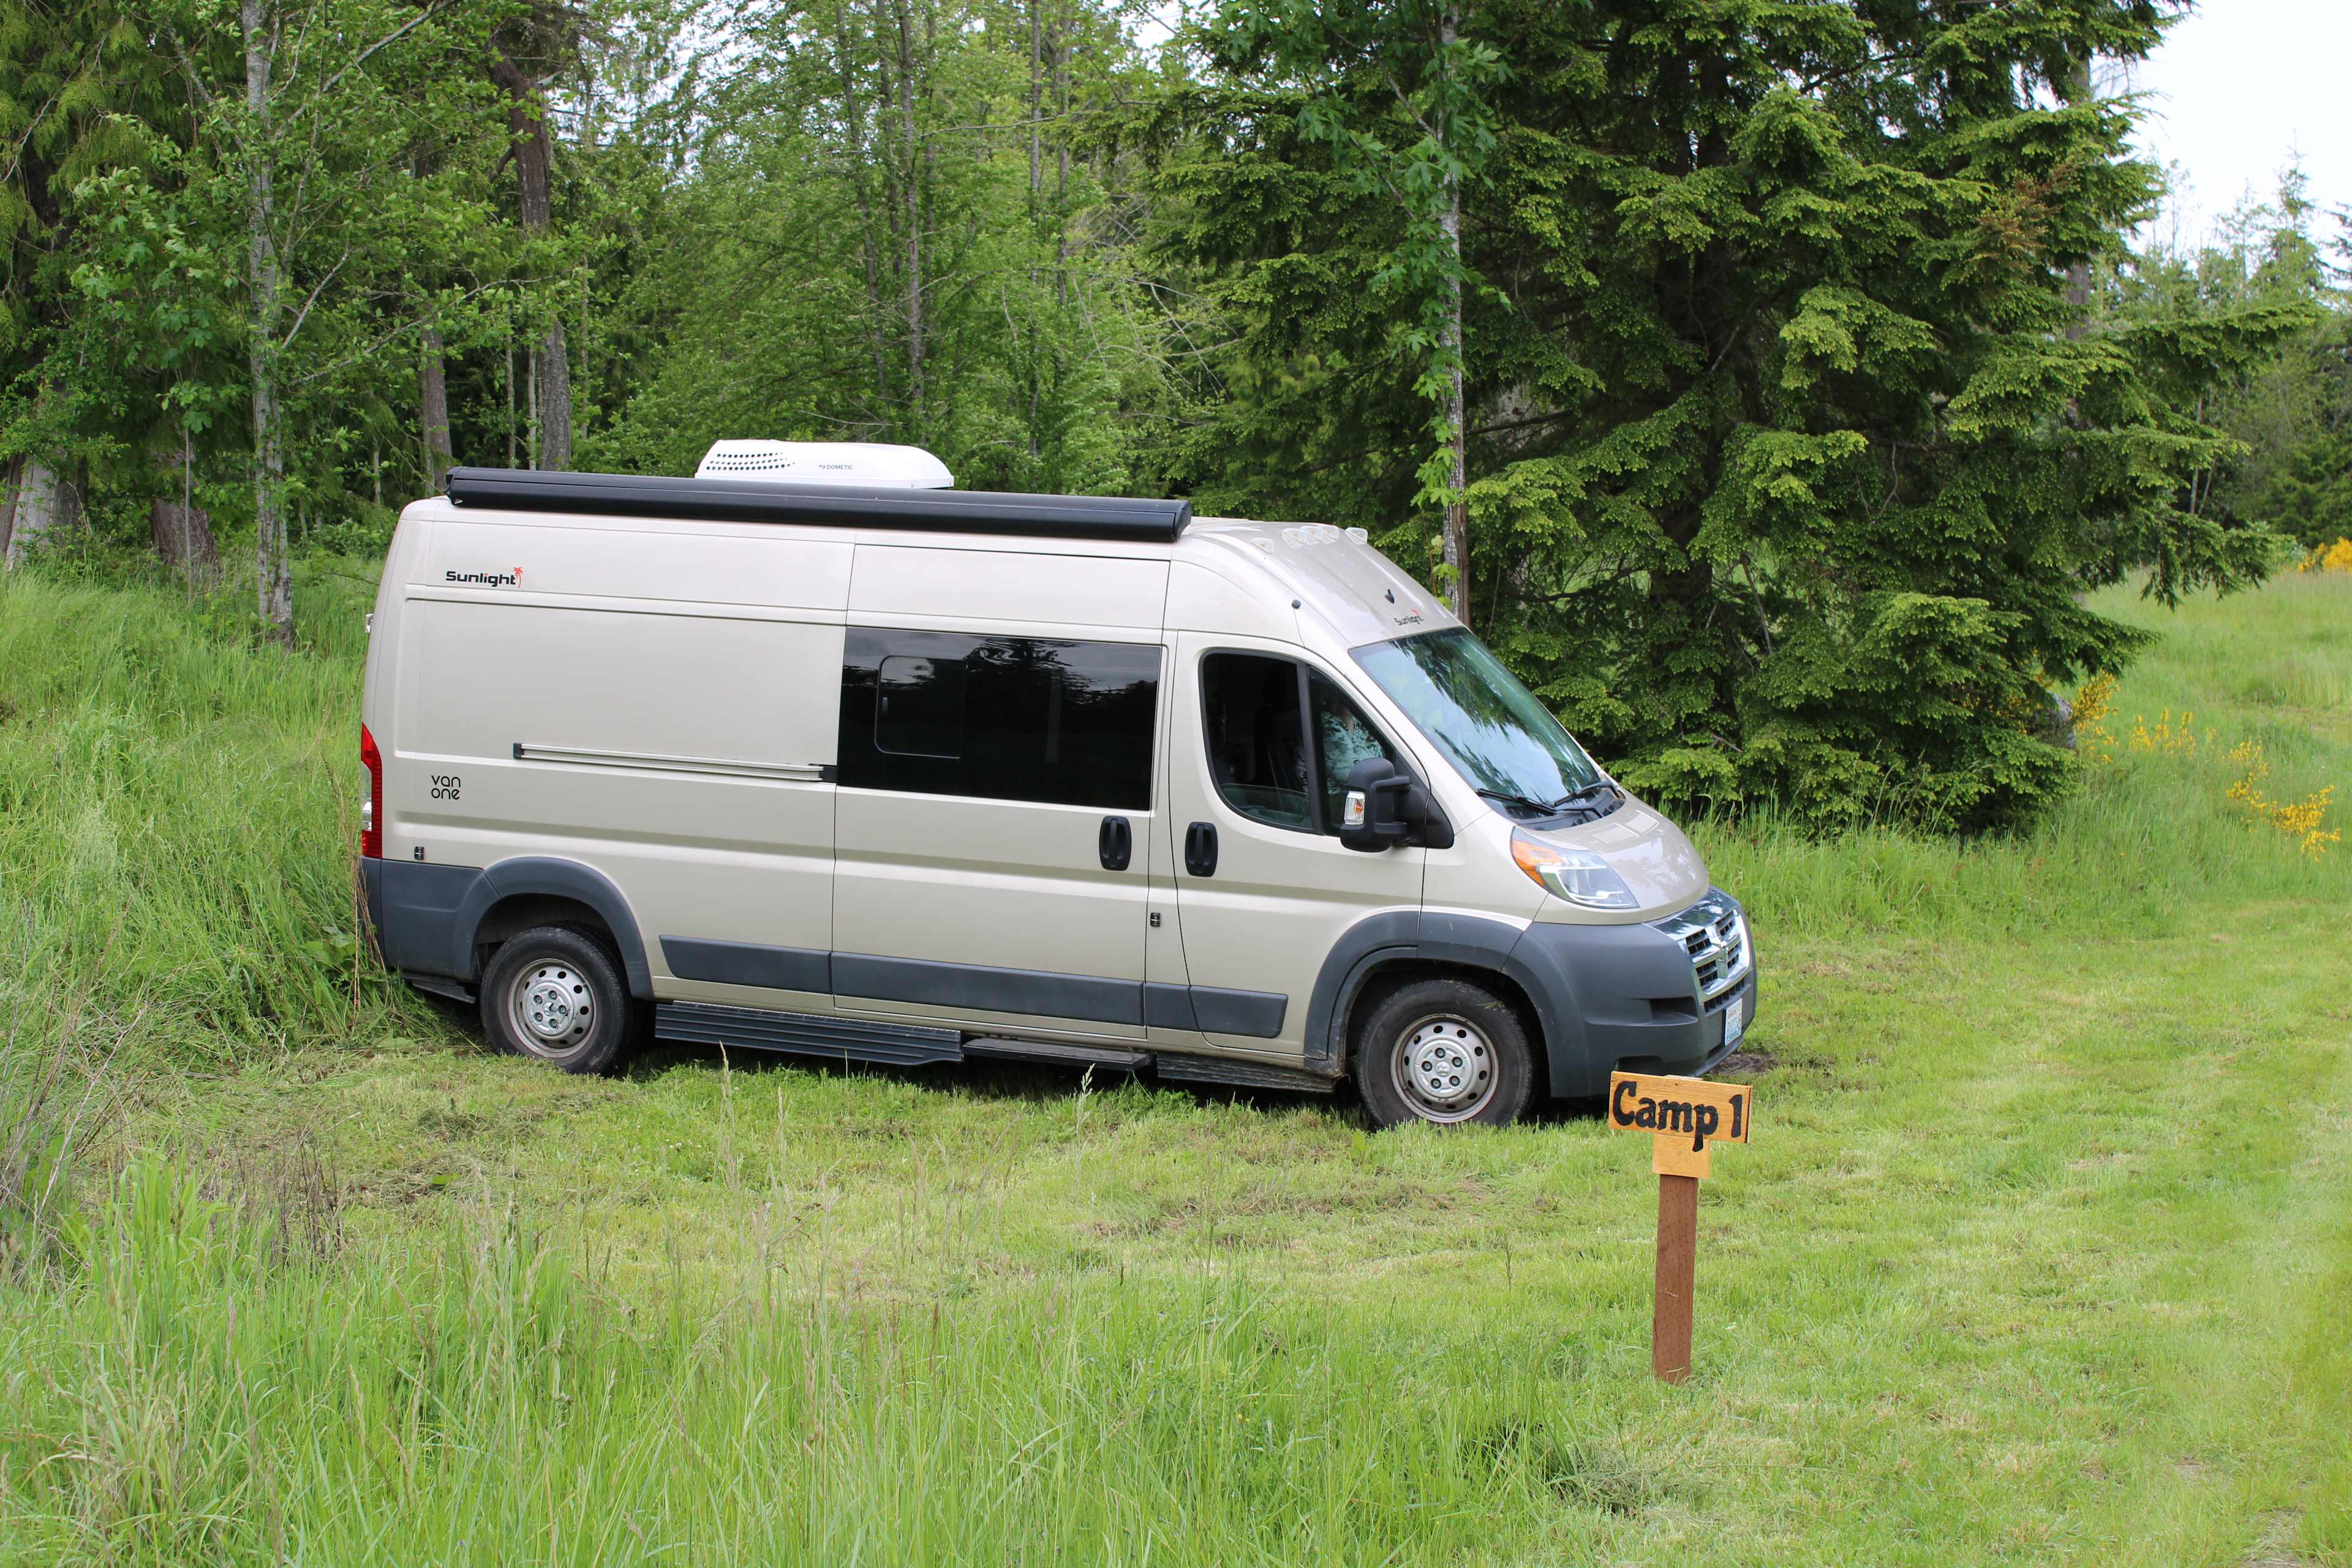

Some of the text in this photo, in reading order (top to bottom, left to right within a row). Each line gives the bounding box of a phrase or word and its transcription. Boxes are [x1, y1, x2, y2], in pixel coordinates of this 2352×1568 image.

[446, 571, 516, 587] Sunlight
[1393, 615, 1425, 625] Sunlight
[1612, 1080, 1743, 1153] Camp 1
